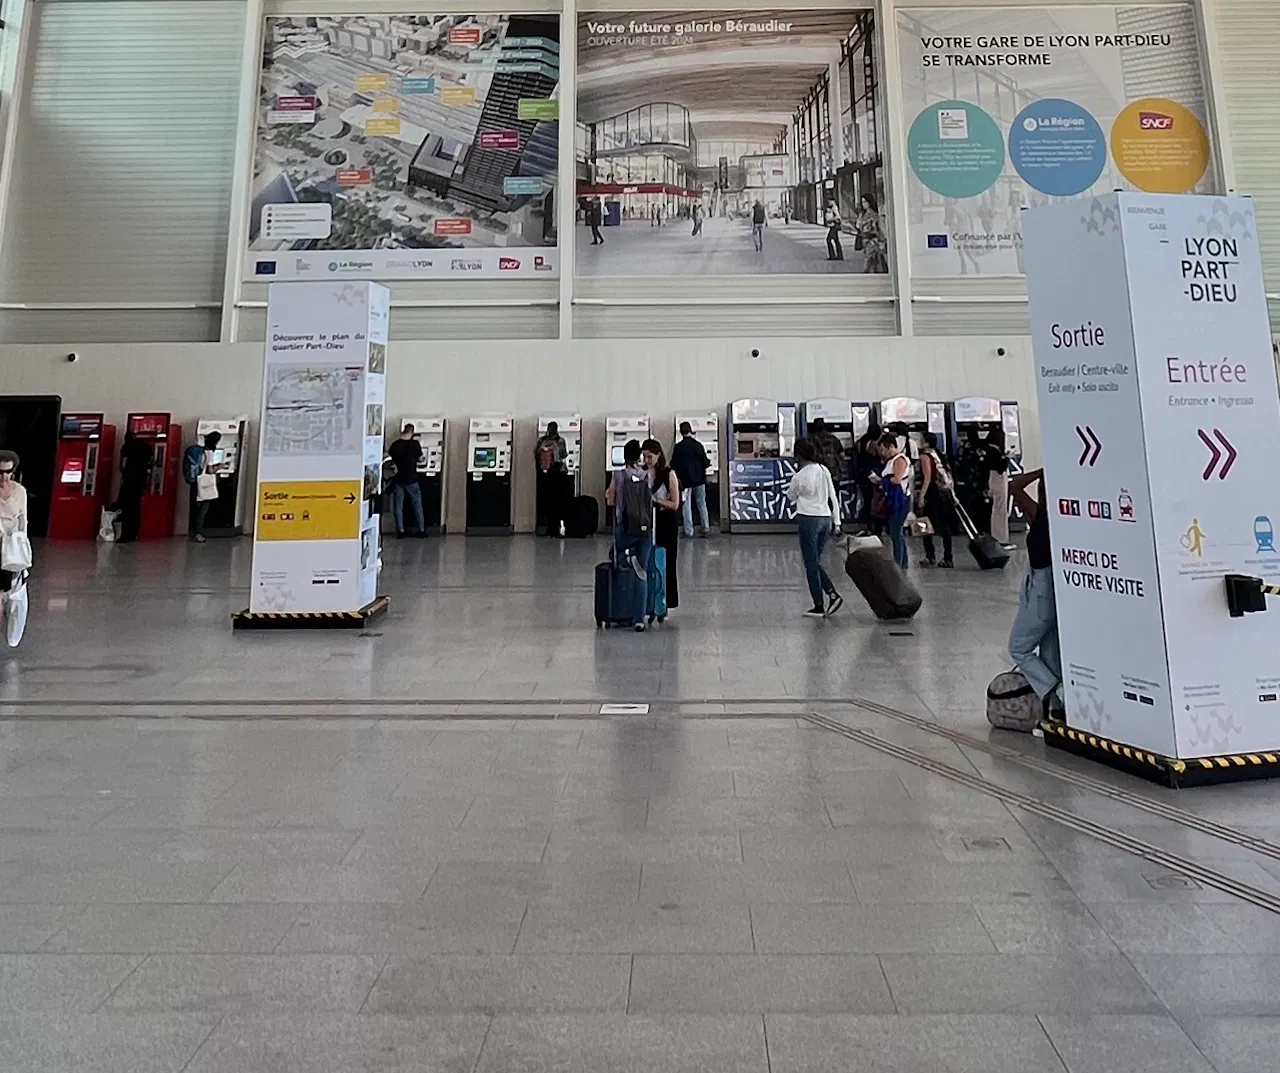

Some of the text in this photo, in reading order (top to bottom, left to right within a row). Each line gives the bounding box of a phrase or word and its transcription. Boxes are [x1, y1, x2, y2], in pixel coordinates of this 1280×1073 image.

[587, 19, 793, 35] Votre future galerie Béraudier
[587, 37, 647, 46] OUVERTURE
[920, 34, 1171, 49] VOTRE GARE DE LYON PART-DIEU
[922, 53, 1051, 66] SE TRANSFORME
[1038, 117, 1085, 127] La Région
[1140, 118, 1171, 129] SNCF
[997, 233, 1012, 241] par
[1185, 238, 1238, 257] LYON
[500, 261, 518, 269] SNCF
[1181, 260, 1231, 279] PART
[1184, 283, 1237, 302] -DIEU
[332, 333, 350, 341] plan
[355, 332, 365, 340] du
[1051, 320, 1105, 349] Sortie
[1081, 363, 1129, 376] Centre-ville
[1166, 357, 1248, 383] Entrée
[1048, 382, 1061, 393] Exit
[1168, 396, 1209, 406] Entrance
[263, 491, 289, 500] Sortie
[1061, 548, 1119, 570] MERCI DE
[1063, 568, 1145, 598] VOTRE VISITE
